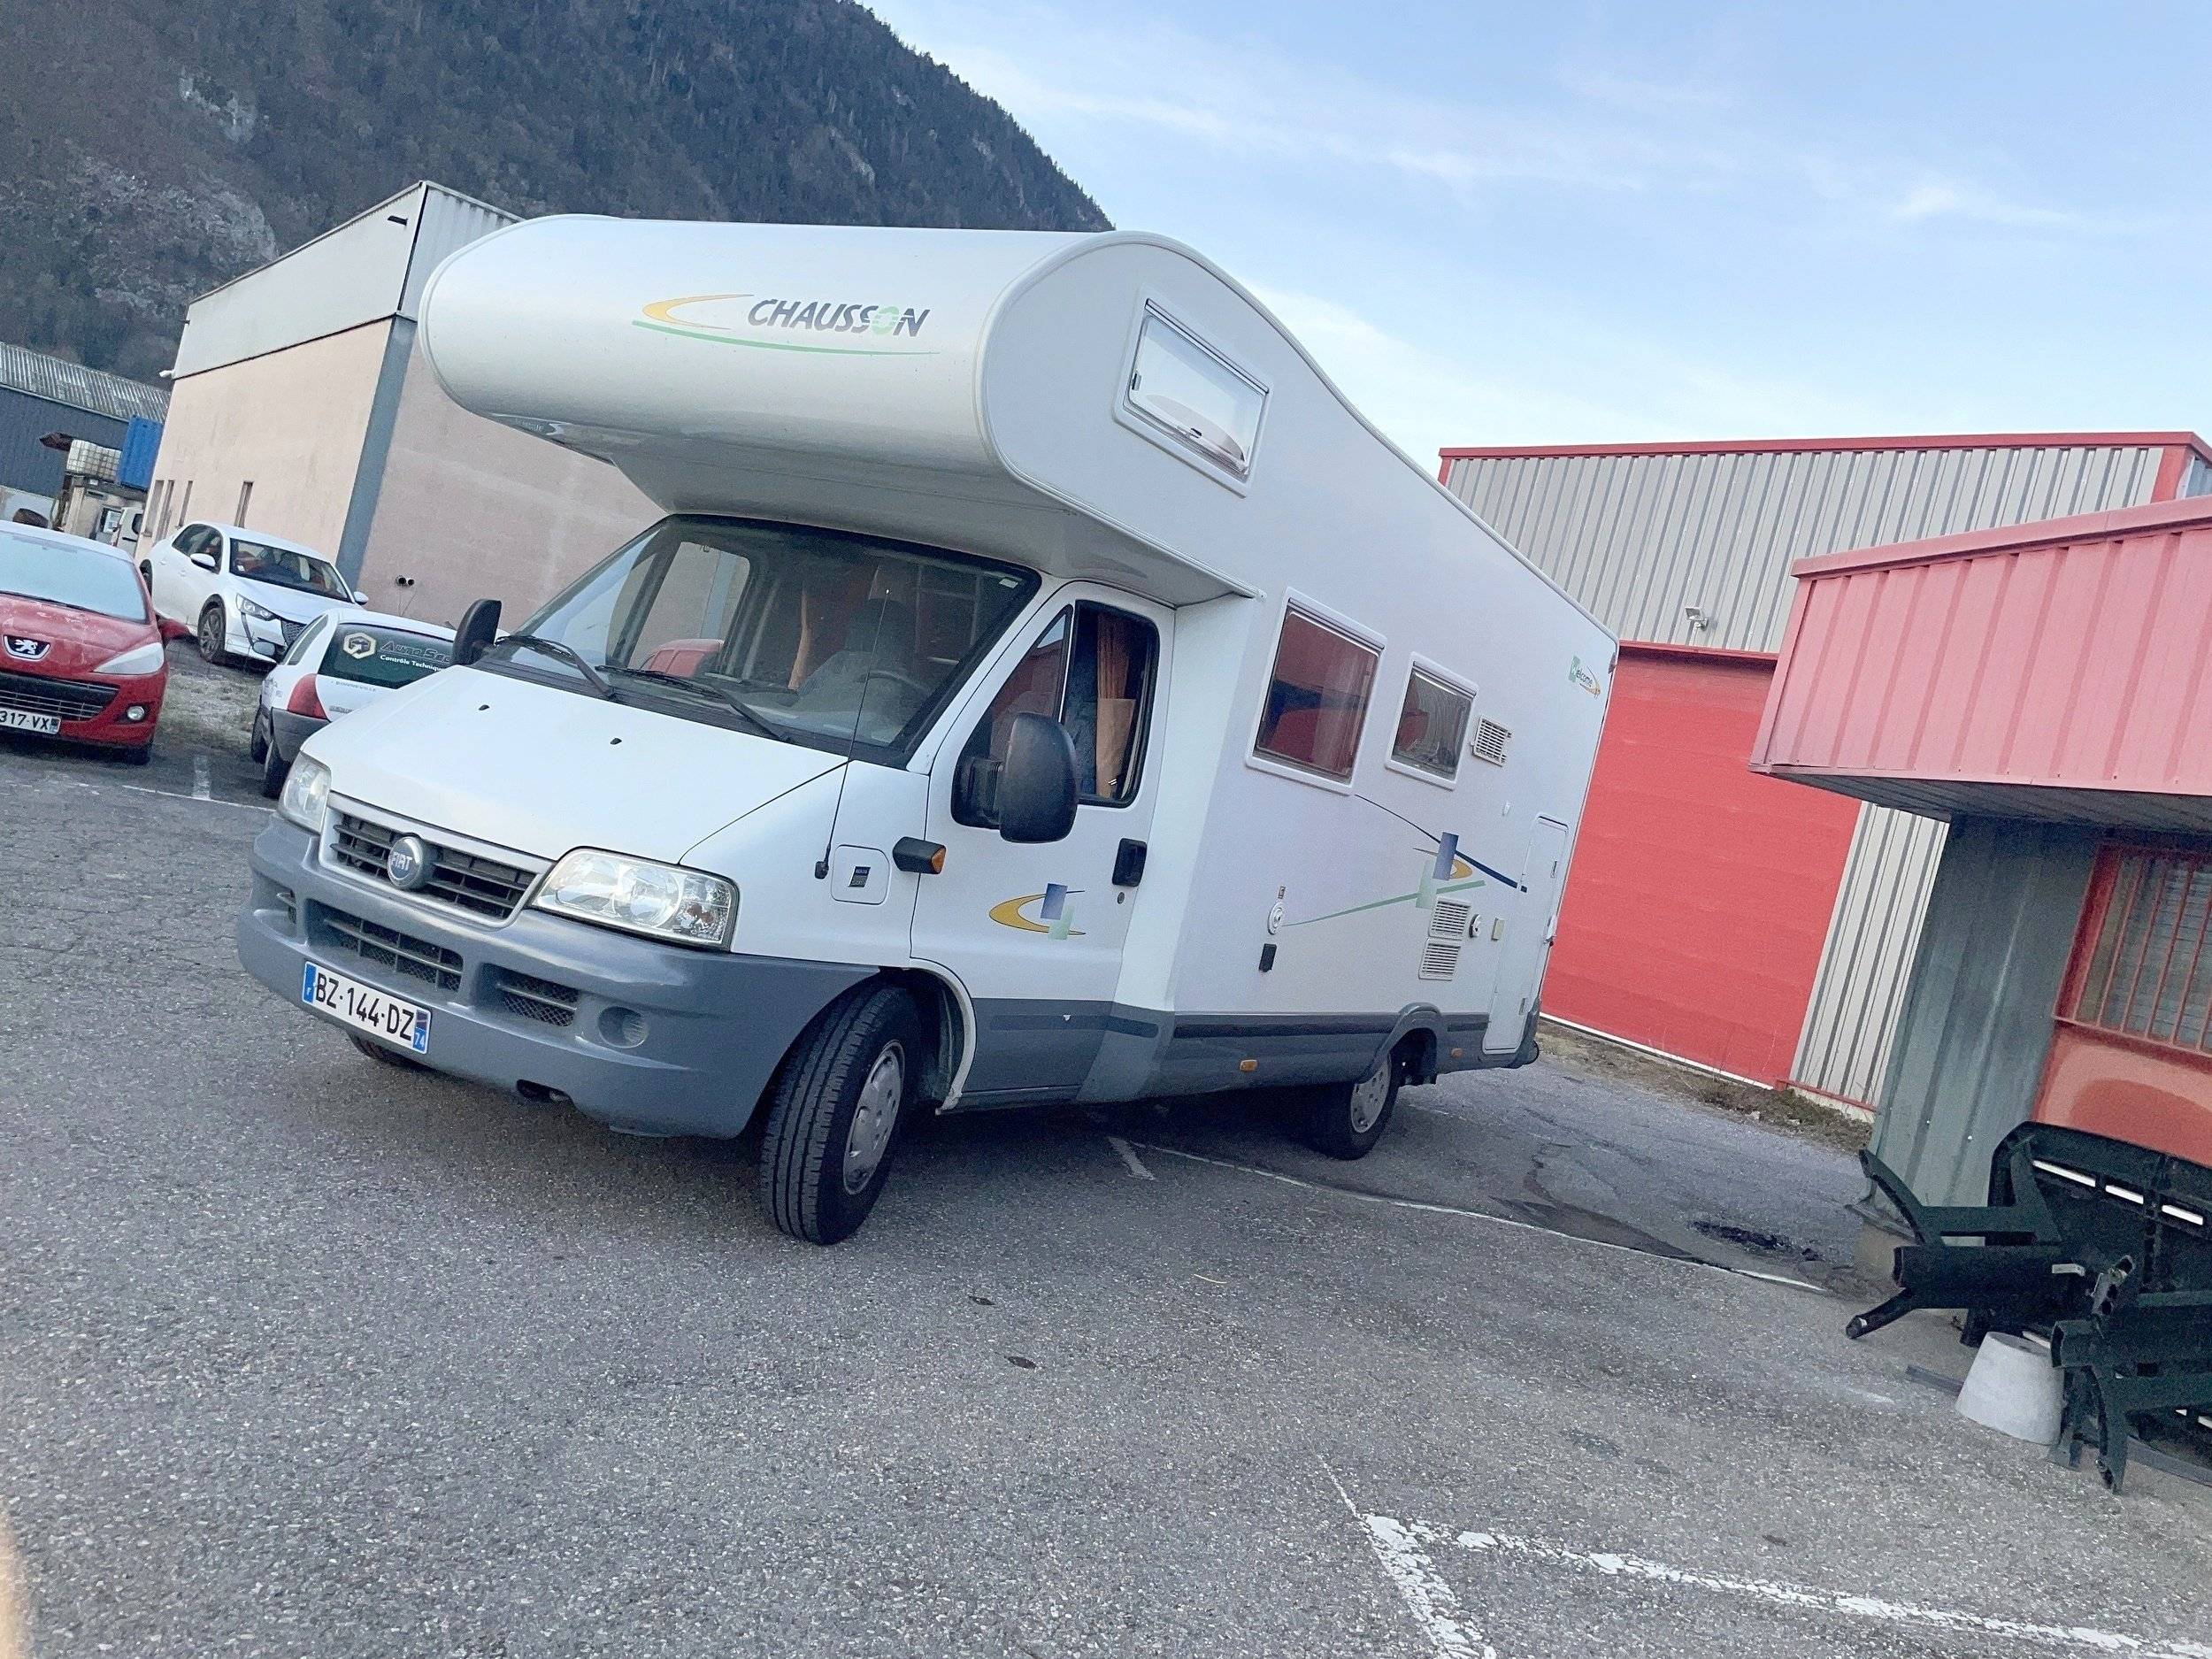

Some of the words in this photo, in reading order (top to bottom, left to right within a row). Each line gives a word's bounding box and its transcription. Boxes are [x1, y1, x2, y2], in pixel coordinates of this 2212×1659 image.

[748, 299, 931, 337] CHAUSSON
[380, 655, 410, 665] Contrôle
[0, 710, 50, 730] 317-VX
[391, 851, 413, 871] FIAT
[316, 972, 415, 1041] BZ-144-DZ
[413, 1032, 426, 1047] 74
